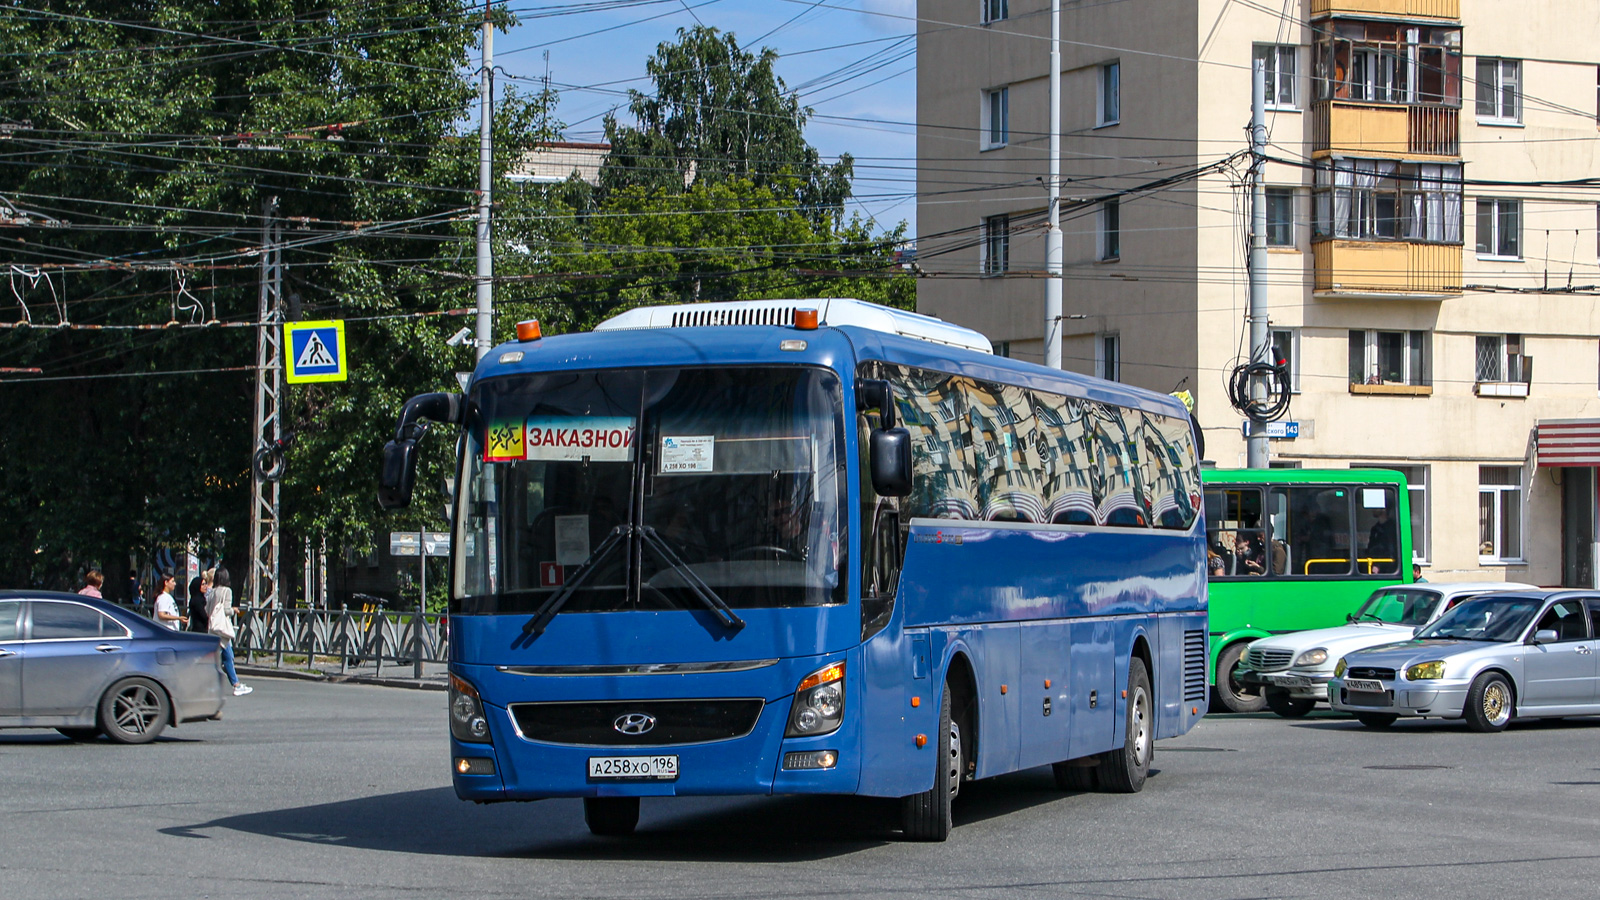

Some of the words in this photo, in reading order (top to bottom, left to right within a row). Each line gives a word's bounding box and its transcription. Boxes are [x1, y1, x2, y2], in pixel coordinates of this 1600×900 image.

[529, 426, 635, 448] ЗАКАЗНОЙ
[1286, 425, 1298, 434] 143
[595, 759, 650, 774] А258ХО
[652, 757, 674, 769] 196
